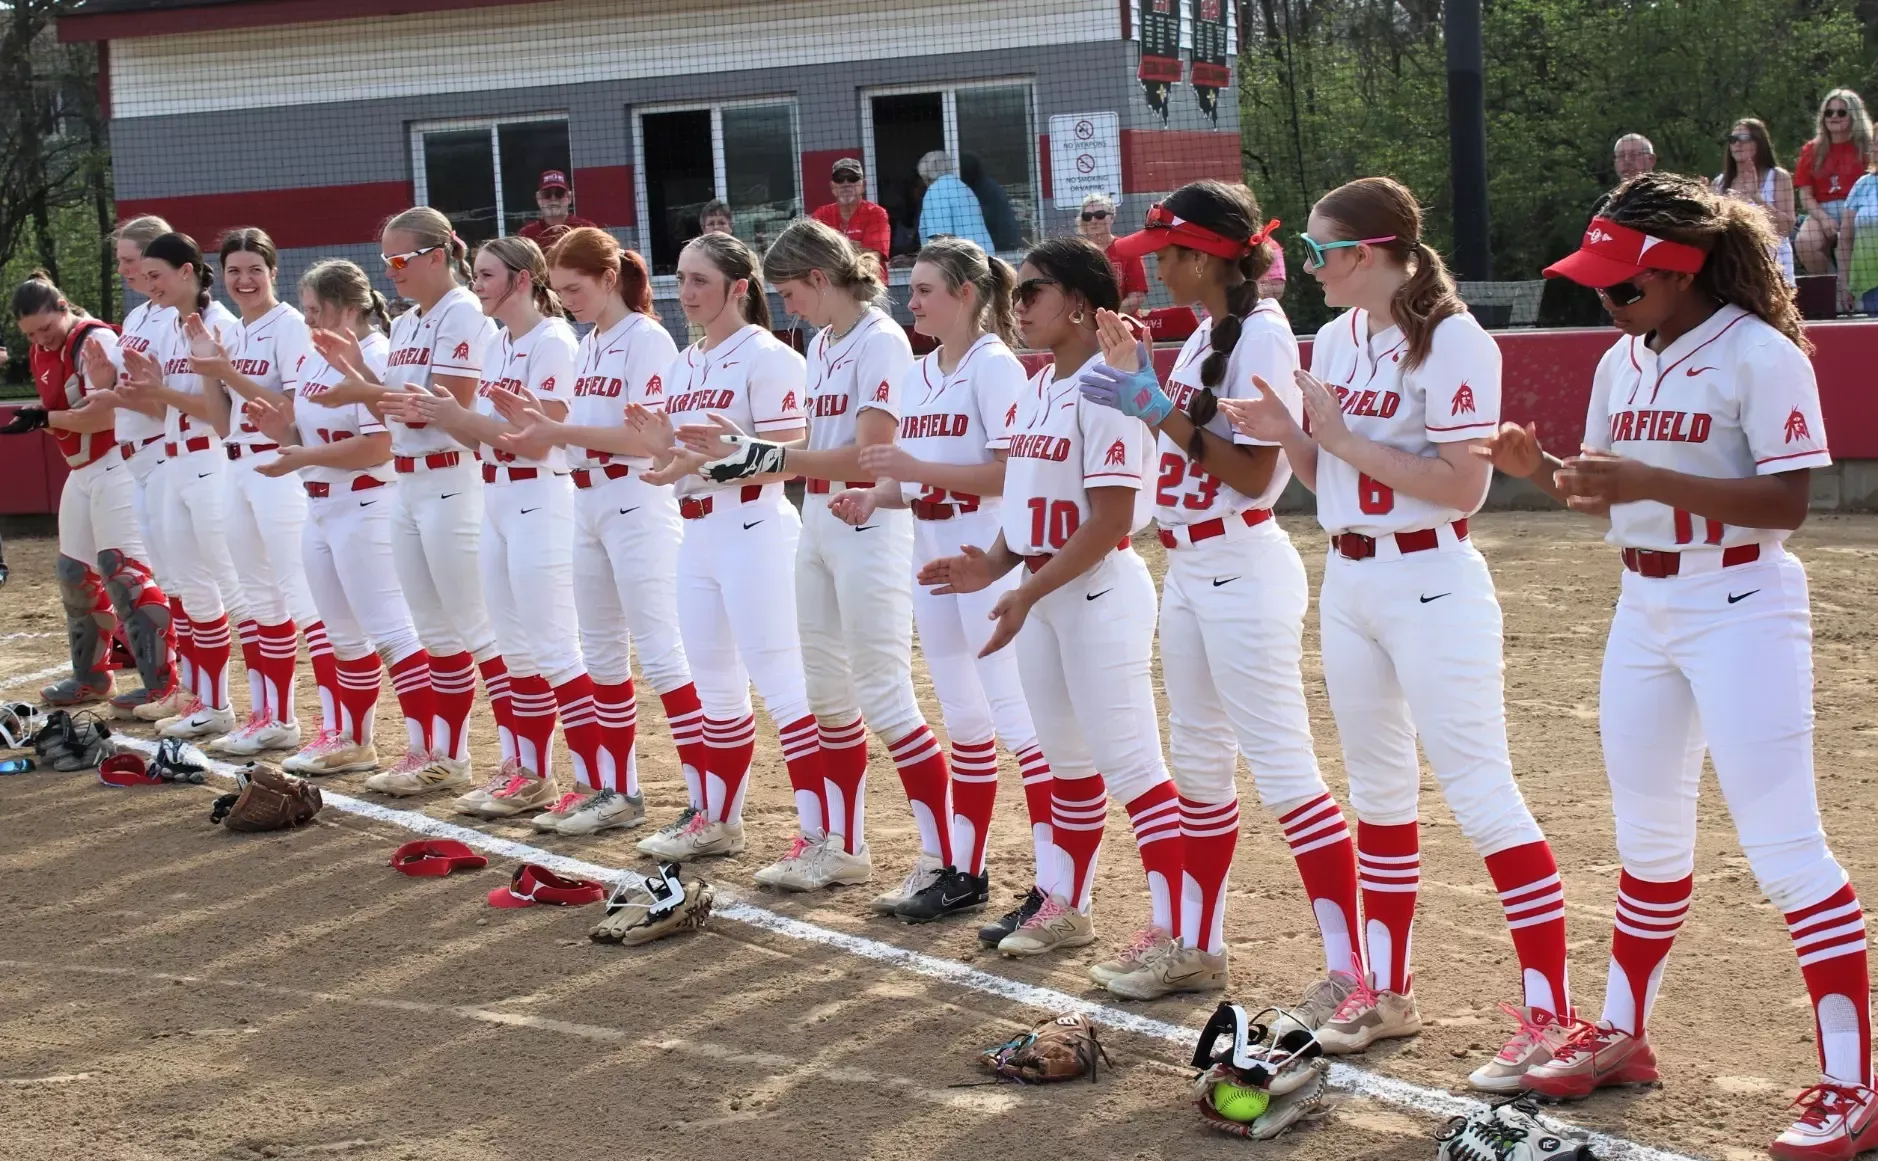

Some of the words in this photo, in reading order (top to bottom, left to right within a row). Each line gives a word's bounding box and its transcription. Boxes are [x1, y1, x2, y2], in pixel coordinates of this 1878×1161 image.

[1076, 140, 1107, 148] WEAPONS
[664, 388, 735, 415] AIRFIELD
[900, 413, 969, 439] IRFIELD
[1155, 451, 1222, 511] 23
[1358, 471, 1395, 516] 6
[1027, 496, 1081, 550] 10
